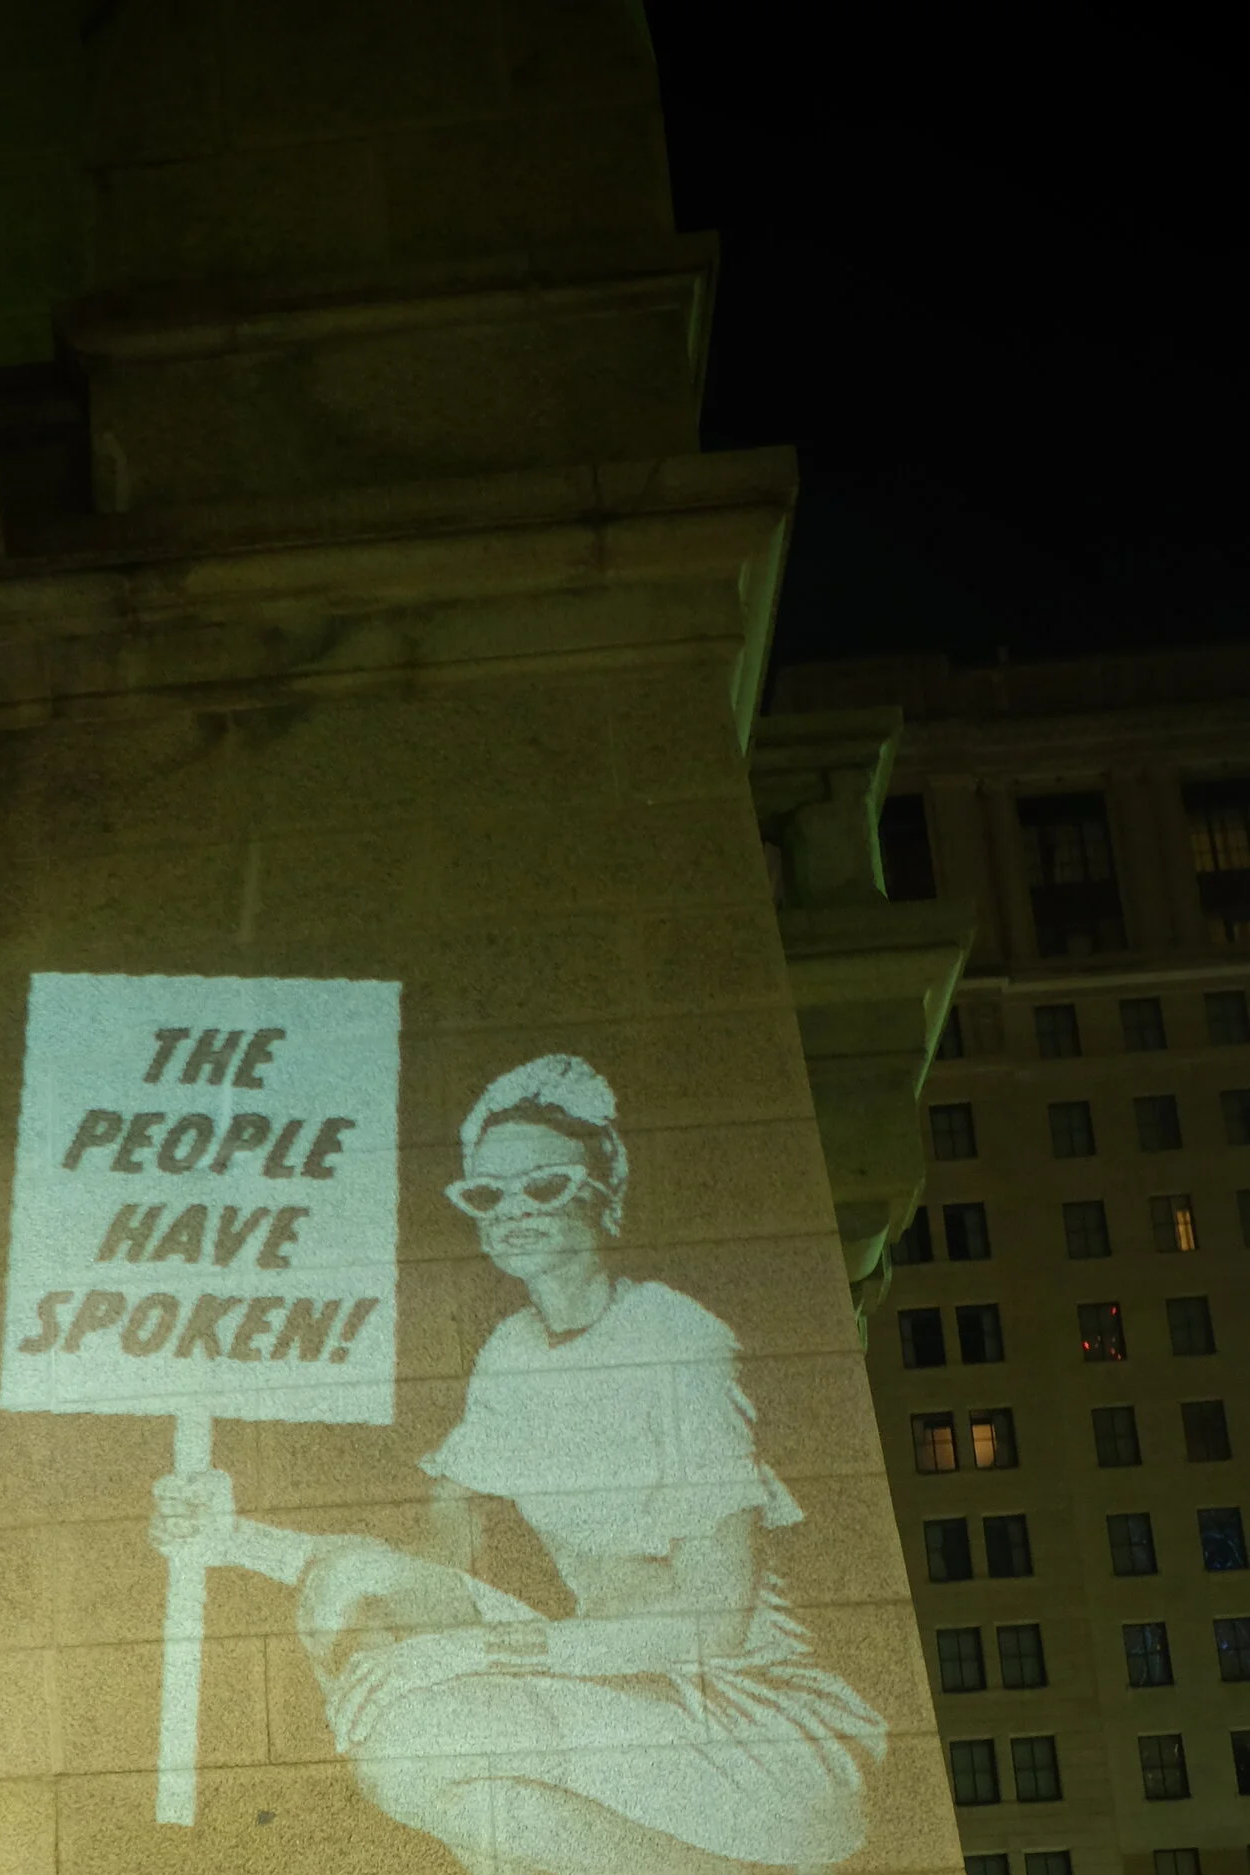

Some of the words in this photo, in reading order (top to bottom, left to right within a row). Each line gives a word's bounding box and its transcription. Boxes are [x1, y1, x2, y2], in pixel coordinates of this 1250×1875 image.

[143, 1027, 286, 1089] THE
[61, 1109, 356, 1180] PEOPLE
[94, 1203, 310, 1269] HAVE
[18, 1289, 380, 1364] SPOKEN!
